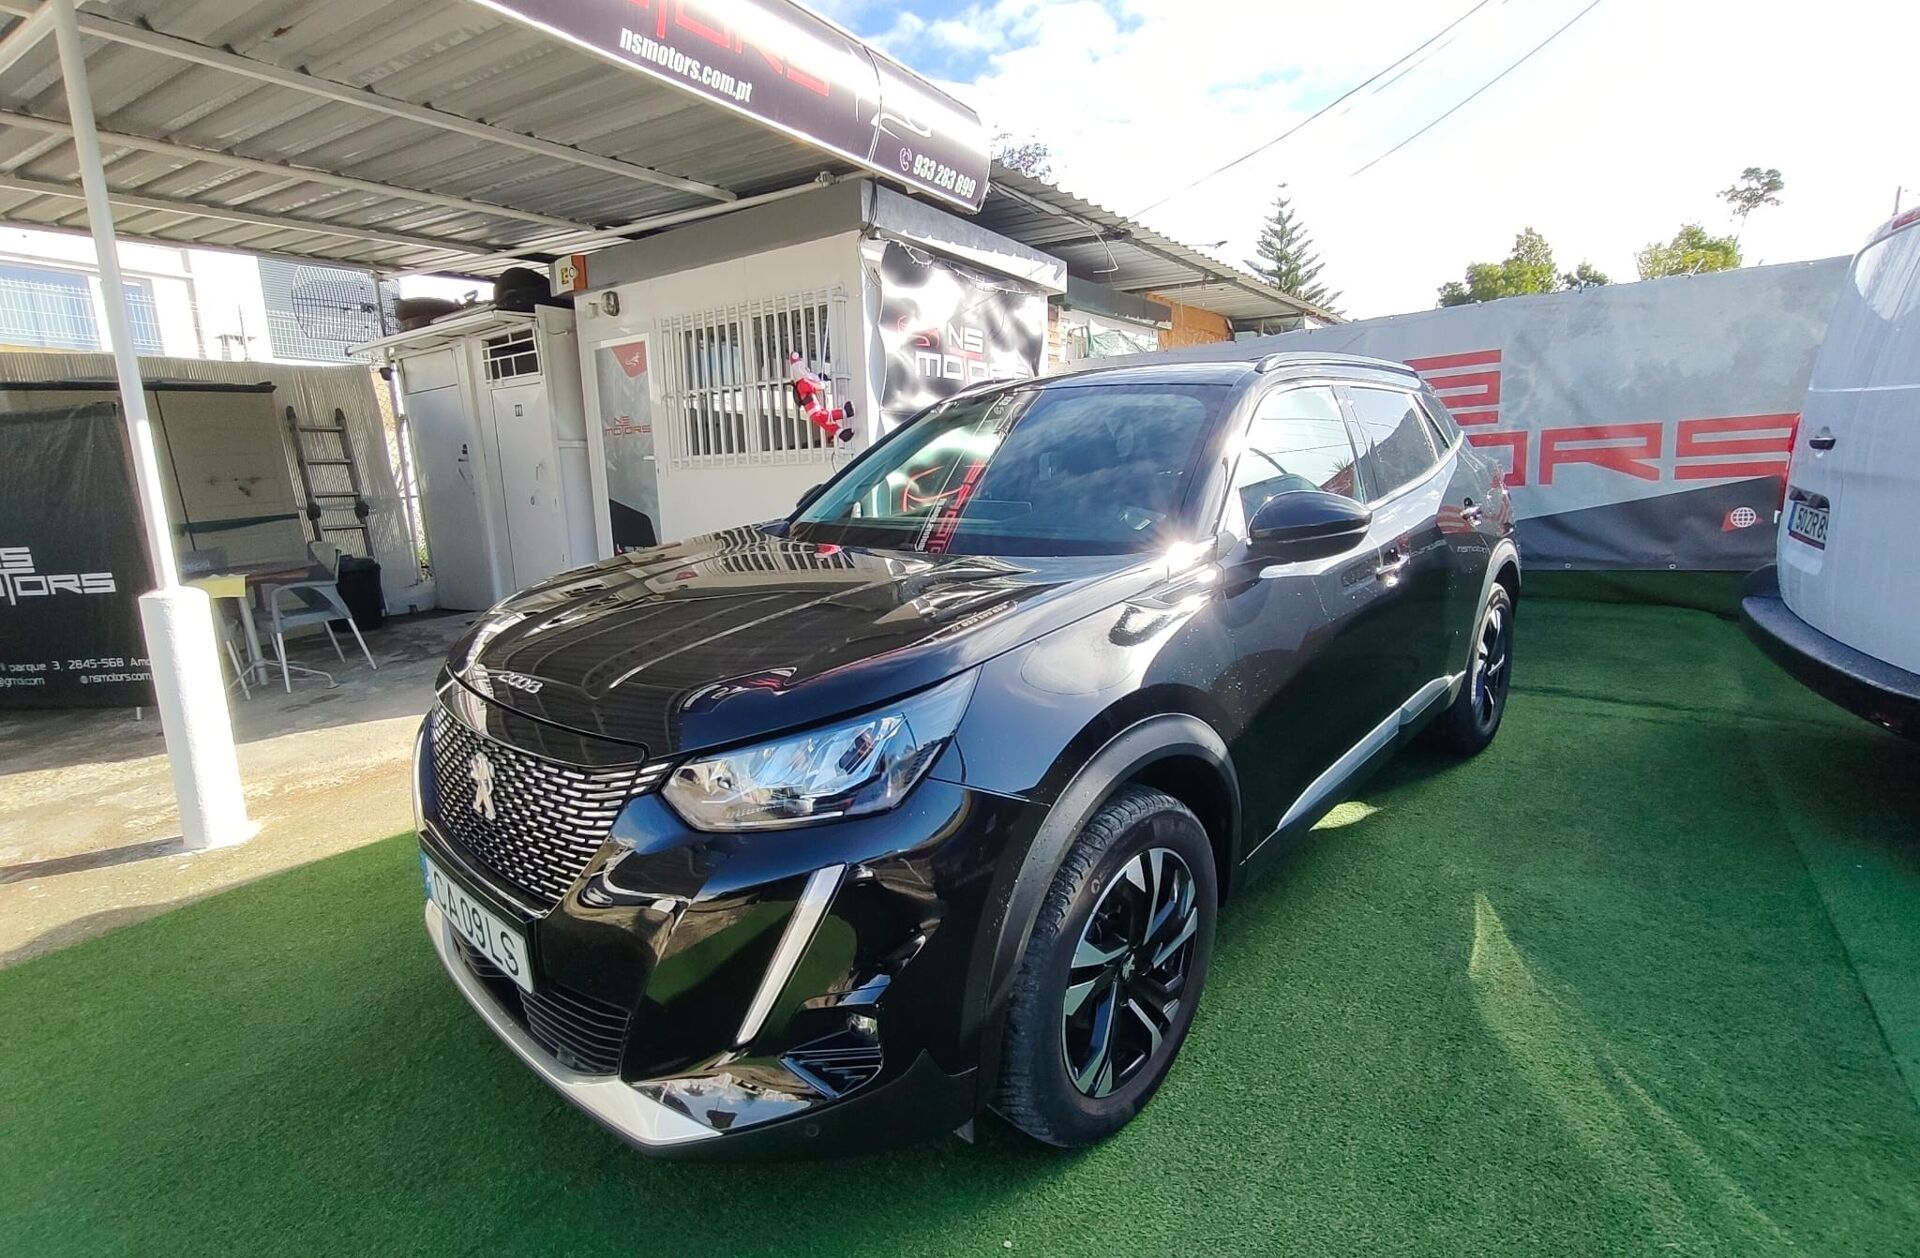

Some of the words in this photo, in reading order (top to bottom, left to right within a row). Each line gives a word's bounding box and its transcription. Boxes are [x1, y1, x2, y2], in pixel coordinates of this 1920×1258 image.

[619, 27, 753, 103] nsmotors.com.pt
[913, 154, 937, 180] 933
[934, 165, 957, 190] 283
[954, 174, 977, 199] 899
[948, 323, 984, 353] NS
[0, 568, 117, 606] TORS
[51, 661, 64, 672] 3,
[67, 658, 125, 670] 2845-568
[499, 672, 544, 694] 2008
